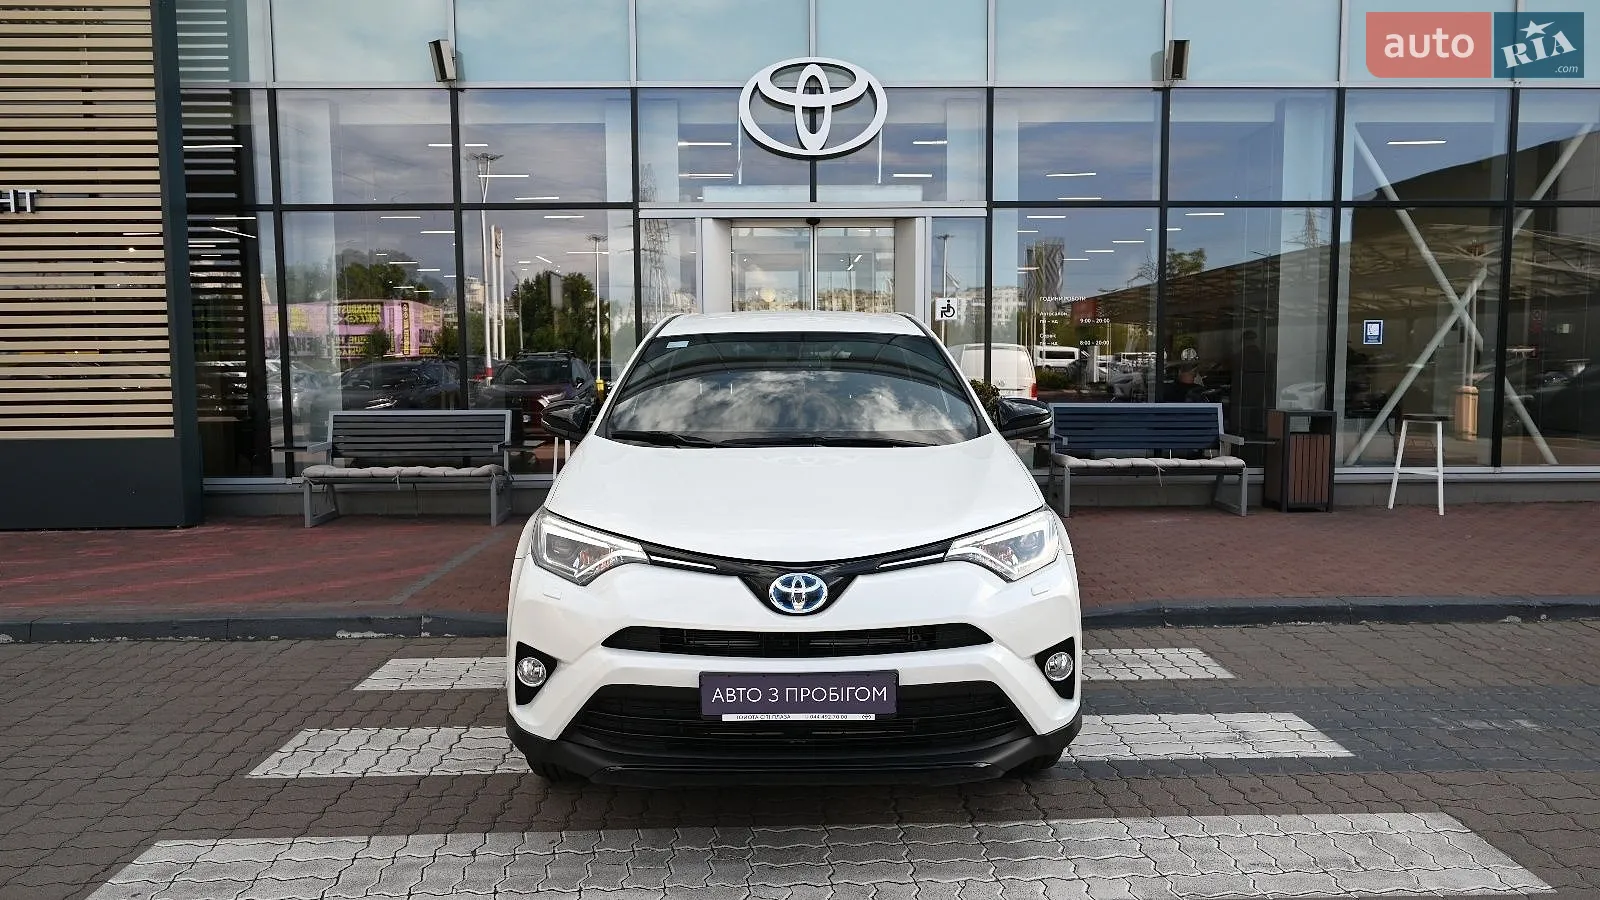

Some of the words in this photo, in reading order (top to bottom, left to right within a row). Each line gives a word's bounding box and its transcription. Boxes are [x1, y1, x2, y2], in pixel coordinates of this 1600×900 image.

[711, 687, 762, 703] АВТО
[768, 687, 779, 703] З
[786, 686, 888, 703] ПРОБІГОМ
